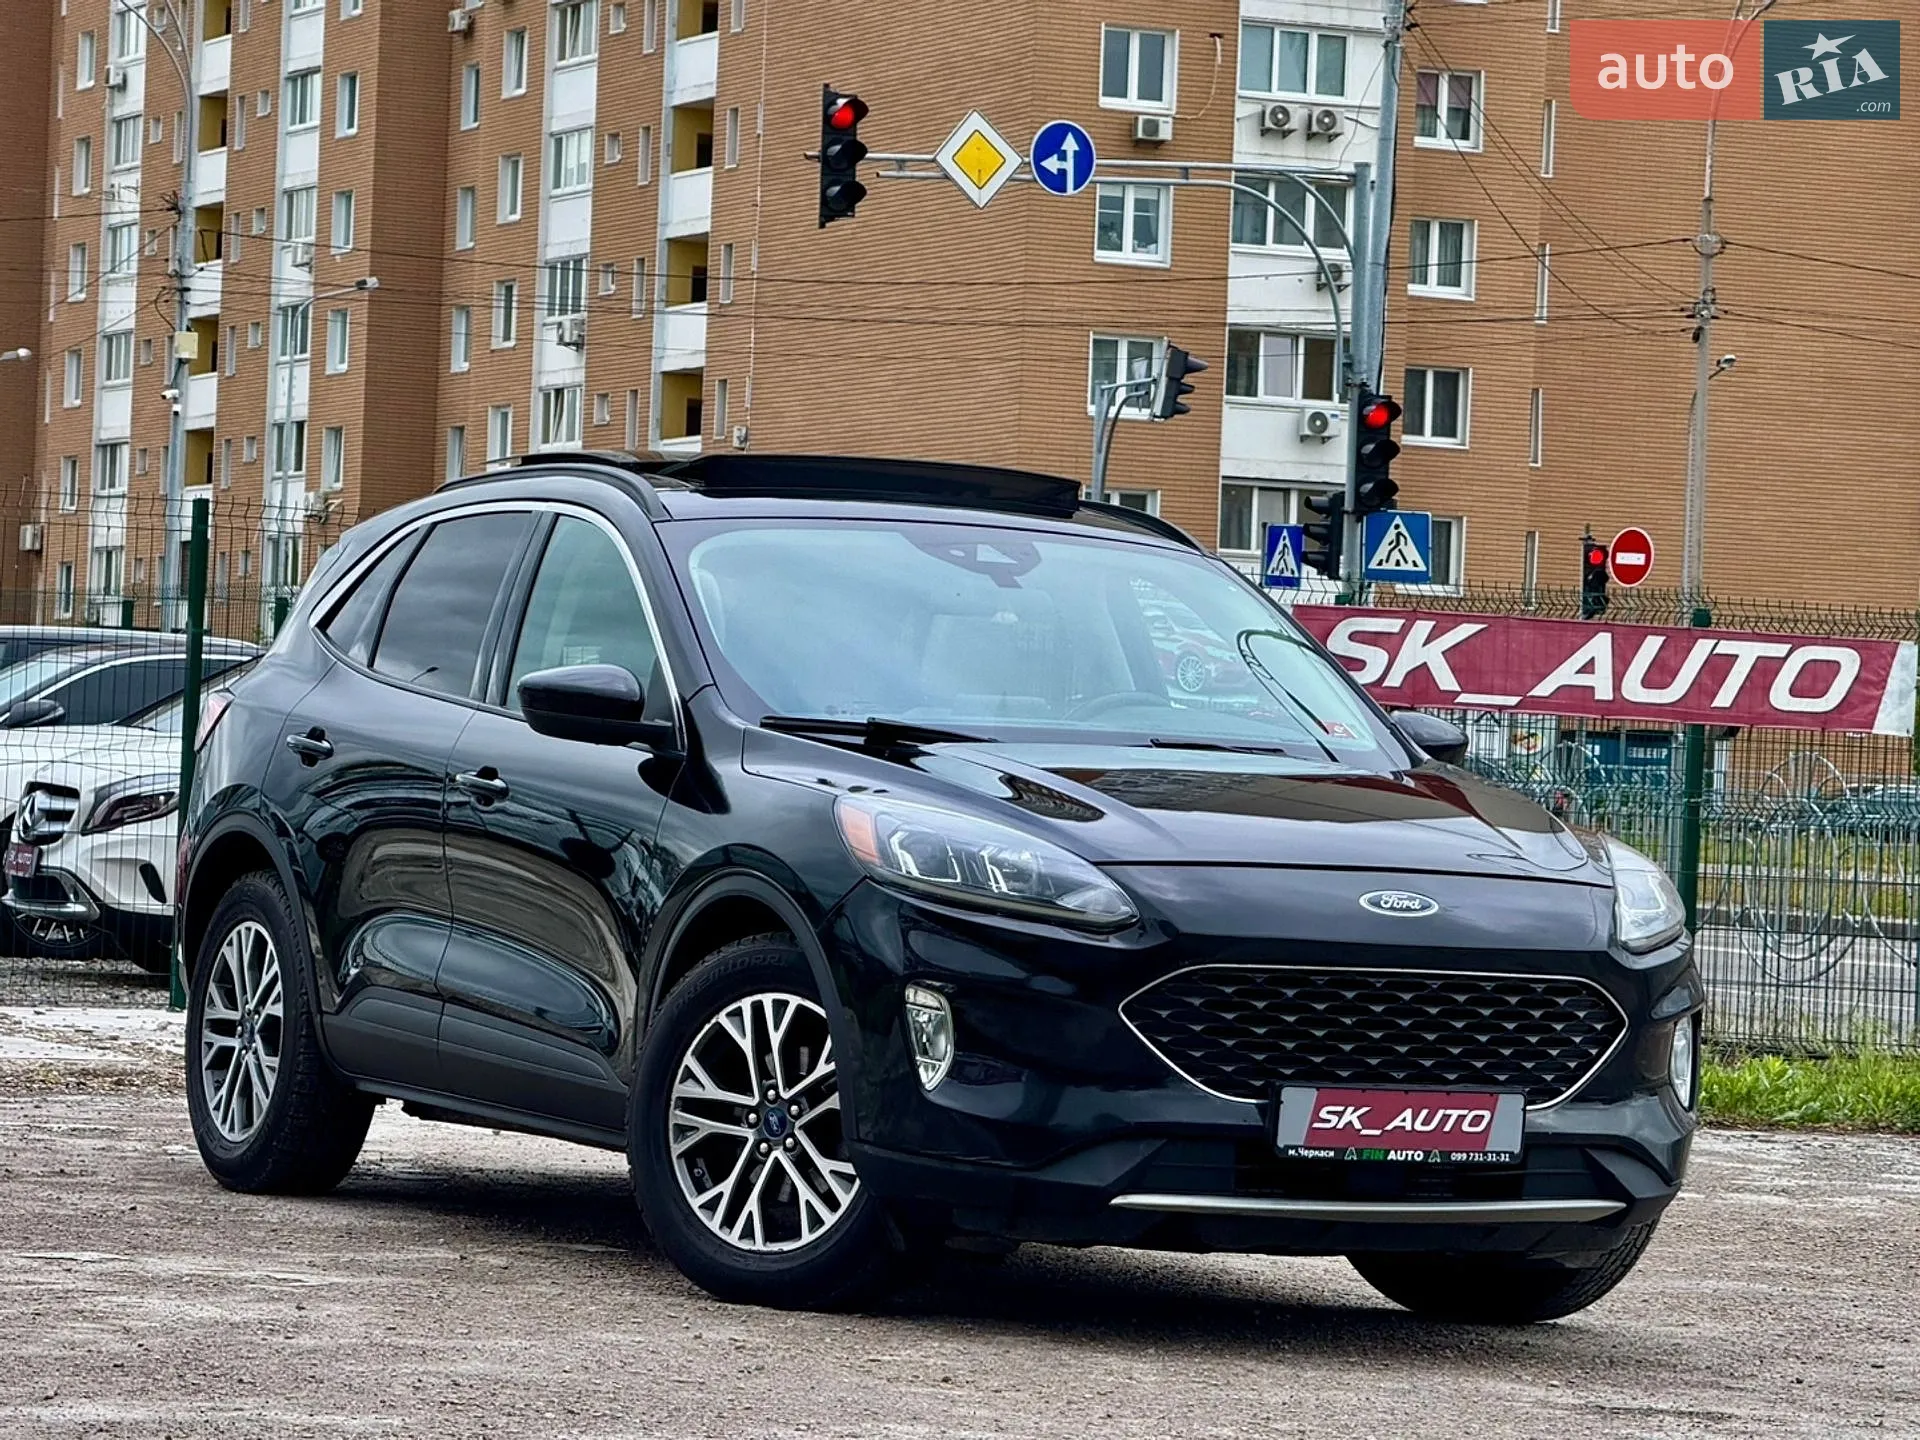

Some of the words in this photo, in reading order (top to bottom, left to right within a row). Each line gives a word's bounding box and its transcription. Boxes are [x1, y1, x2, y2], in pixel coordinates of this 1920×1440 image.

[1326, 616, 1862, 714] SK_AUTO
[1380, 894, 1422, 910] Ford
[1312, 1105, 1492, 1136] SK_AUTO
[1287, 1147, 1335, 1159] м.Черкаси
[1362, 1149, 1385, 1160] FIN
[1386, 1150, 1425, 1161] AUTO
[1450, 1152, 1468, 1162] 099
[1468, 1152, 1511, 1162] 731-31-31
